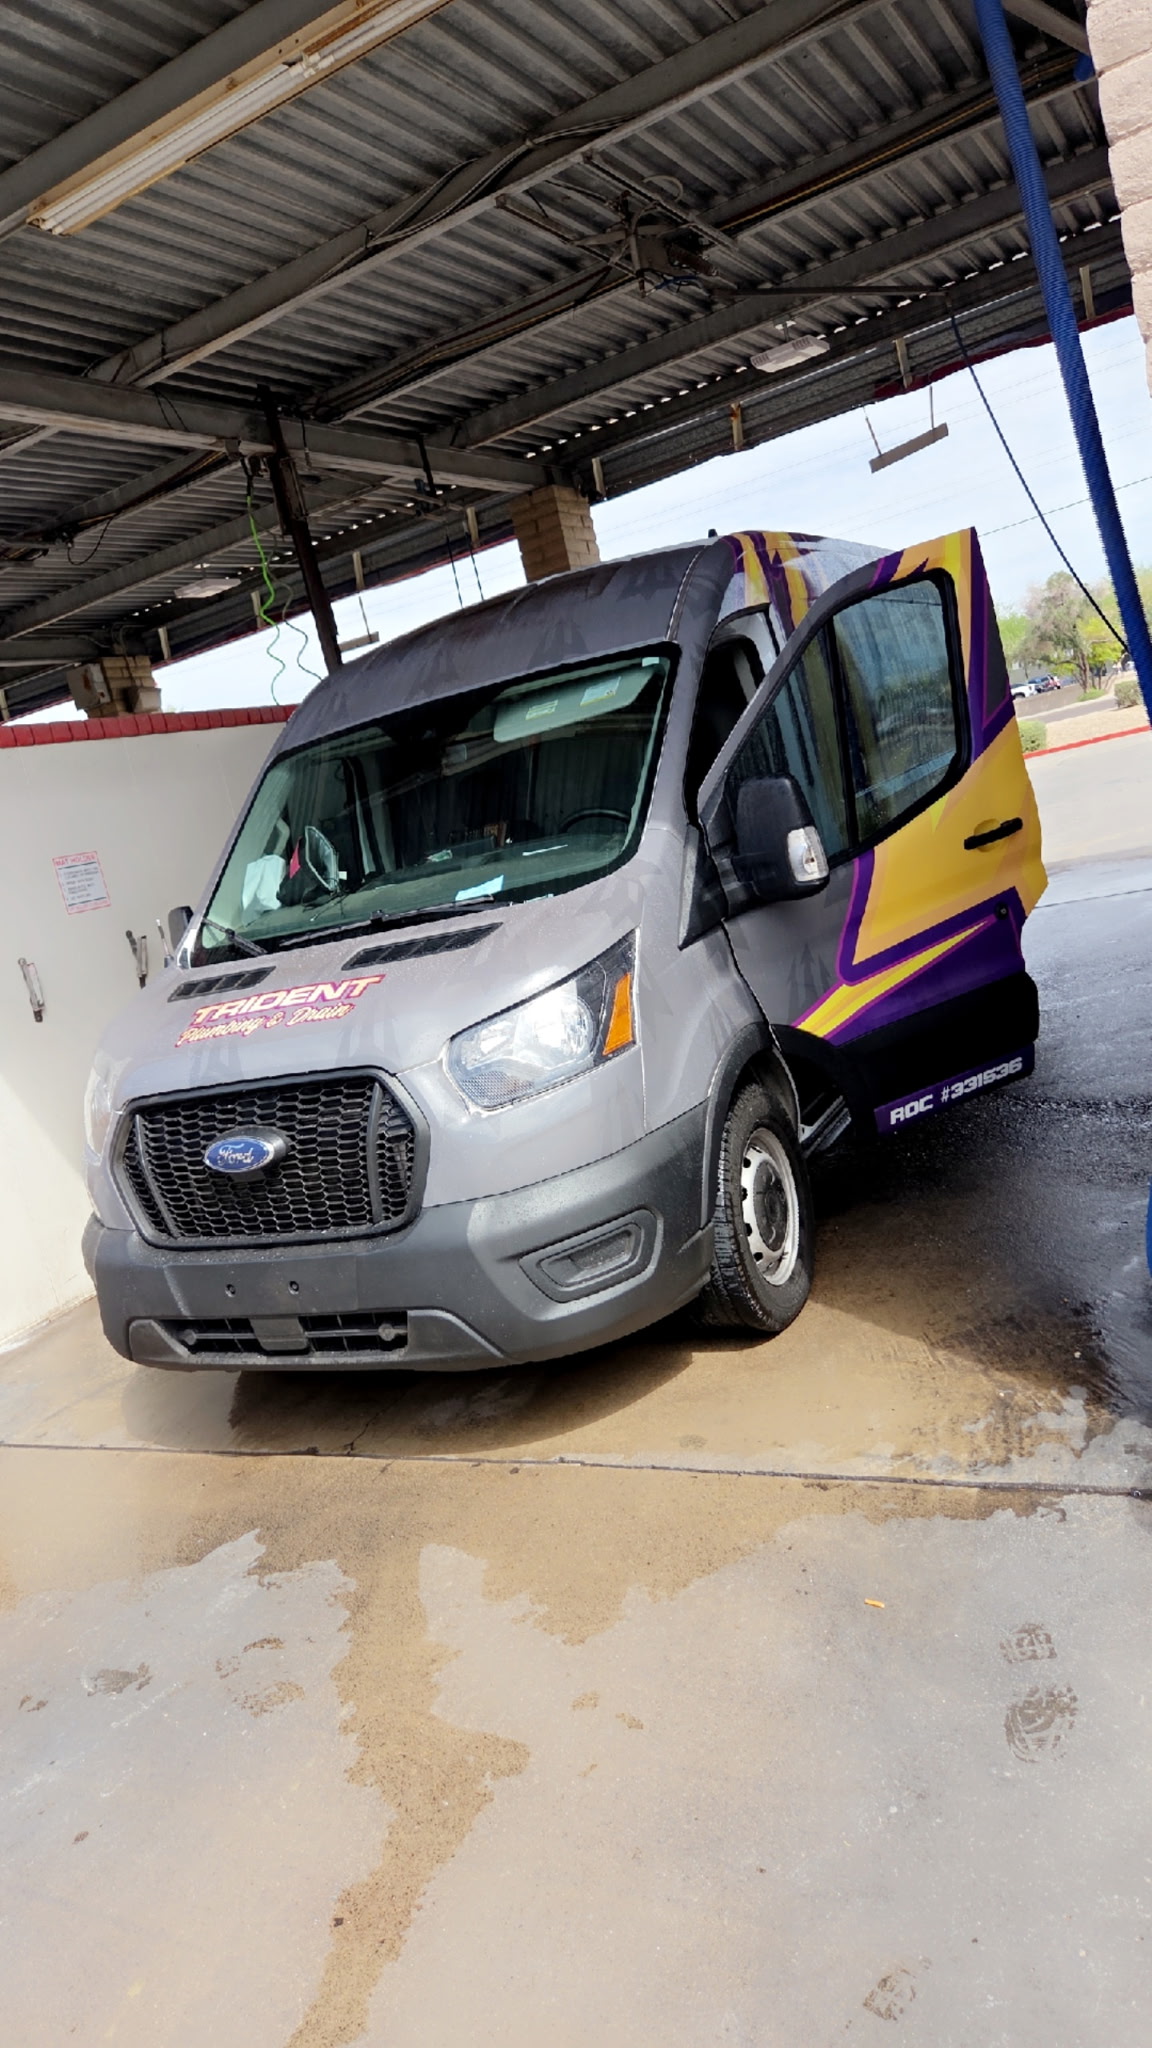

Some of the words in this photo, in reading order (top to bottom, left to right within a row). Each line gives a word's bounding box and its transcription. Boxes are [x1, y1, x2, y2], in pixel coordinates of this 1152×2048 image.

[190, 974, 386, 1026] TRIDENT
[175, 1016, 264, 1047] Plumbing
[264, 1011, 286, 1029] &
[285, 1002, 356, 1028] Drain
[890, 1094, 934, 1125] ROC
[940, 1056, 1023, 1103] #331536
[217, 1143, 255, 1166] Ford
